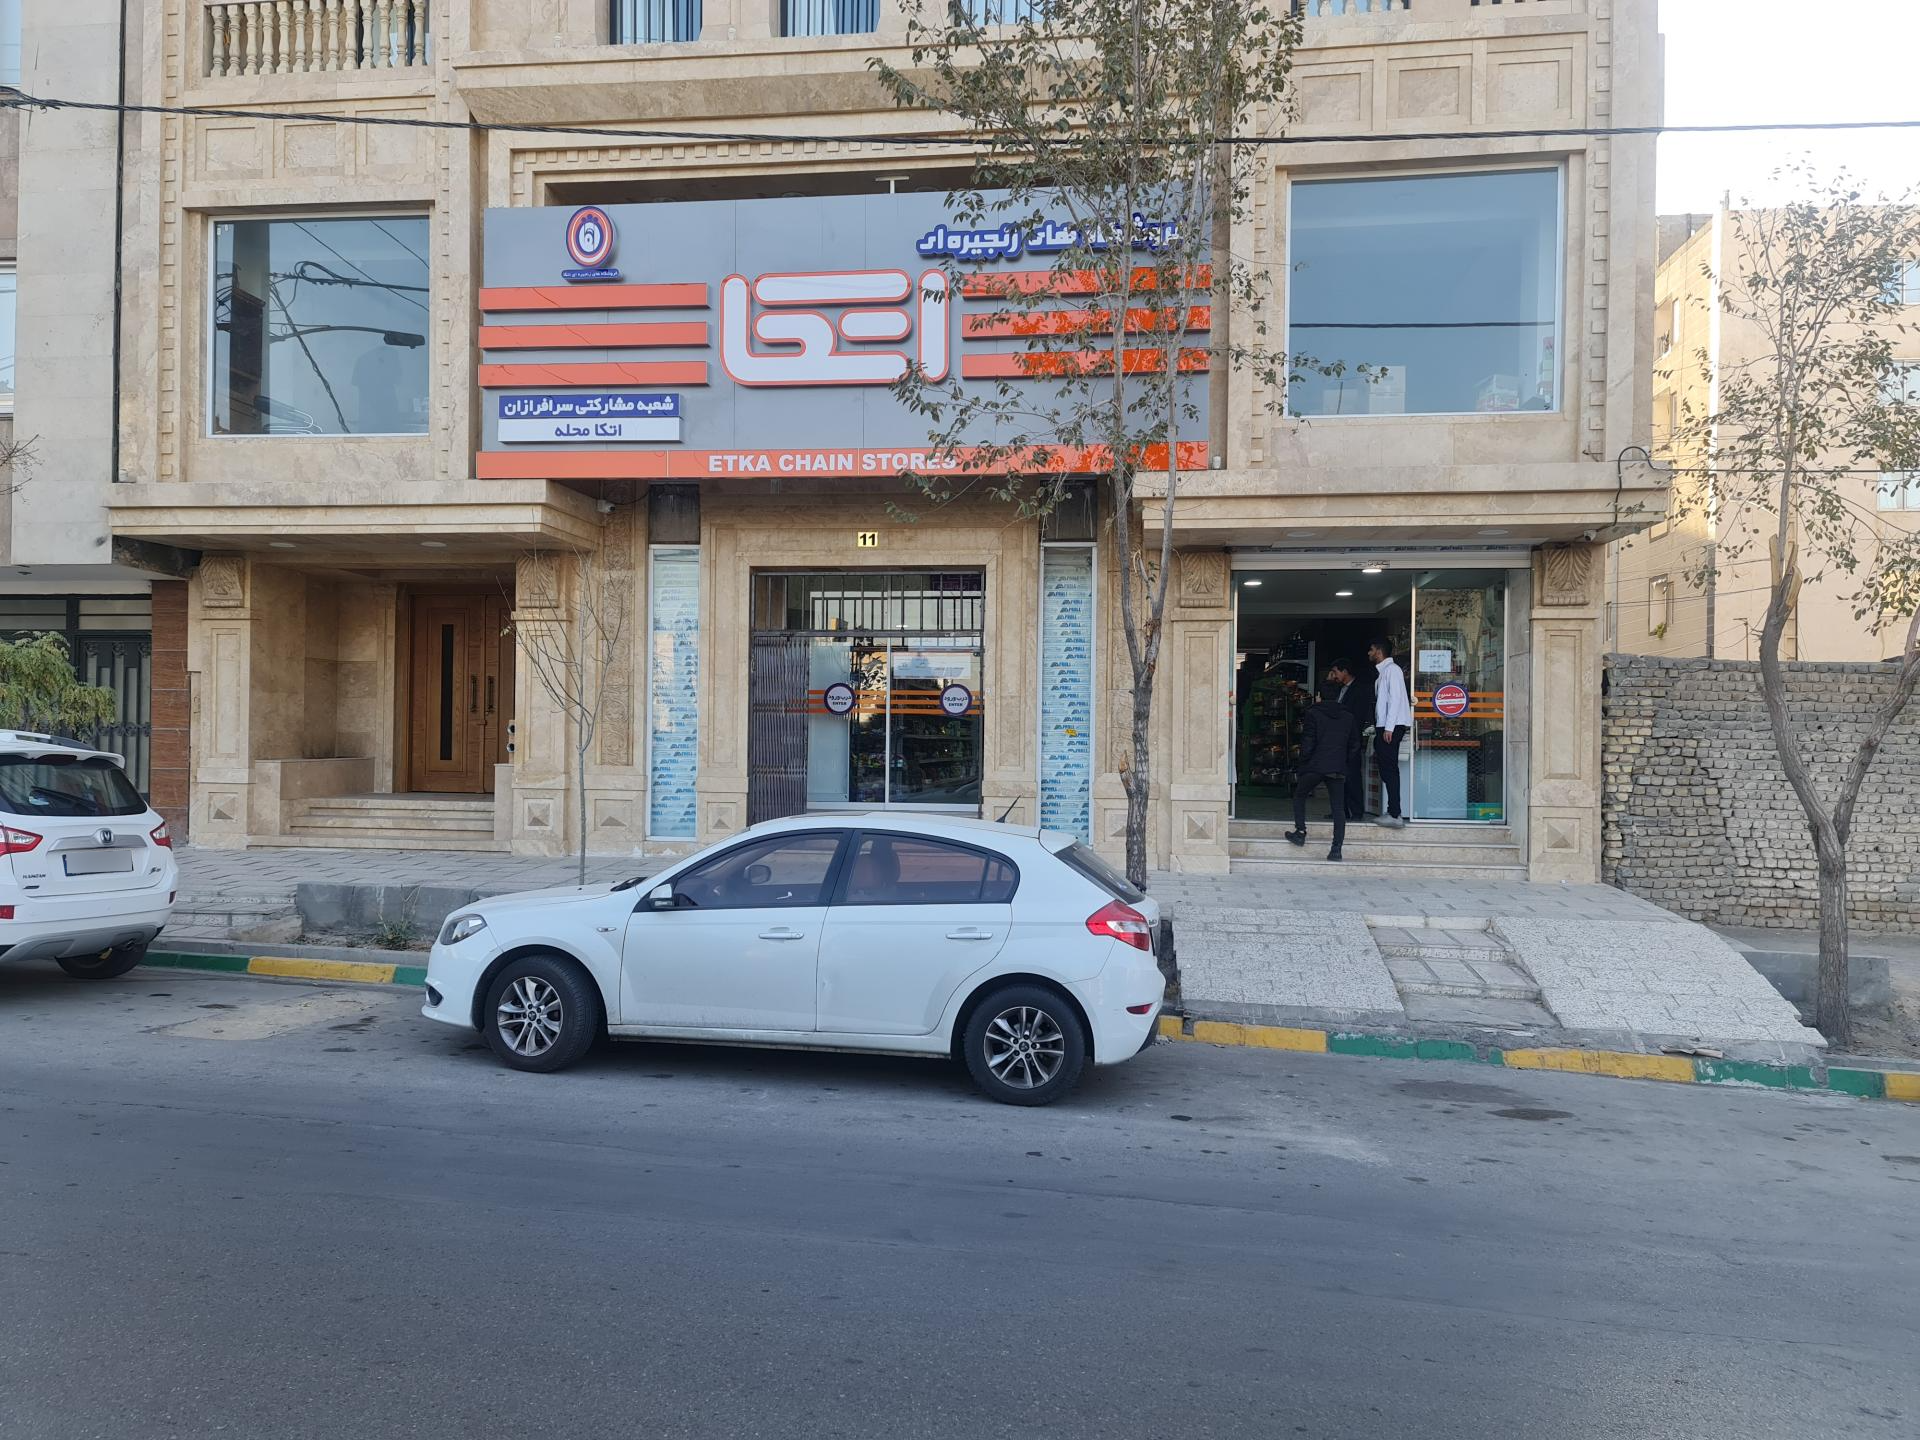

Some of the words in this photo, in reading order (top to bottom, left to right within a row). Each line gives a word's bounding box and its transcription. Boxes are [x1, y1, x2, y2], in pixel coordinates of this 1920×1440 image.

[504, 398, 573, 415] سرافرازان
[576, 397, 634, 415] مشارکتی
[637, 396, 674, 415] شعبه
[555, 424, 590, 437] محله
[595, 423, 622, 437] اتکا
[708, 454, 771, 473] ETKA
[778, 454, 853, 472] CHAIN
[862, 453, 957, 471] STORES
[860, 533, 875, 546] 11
